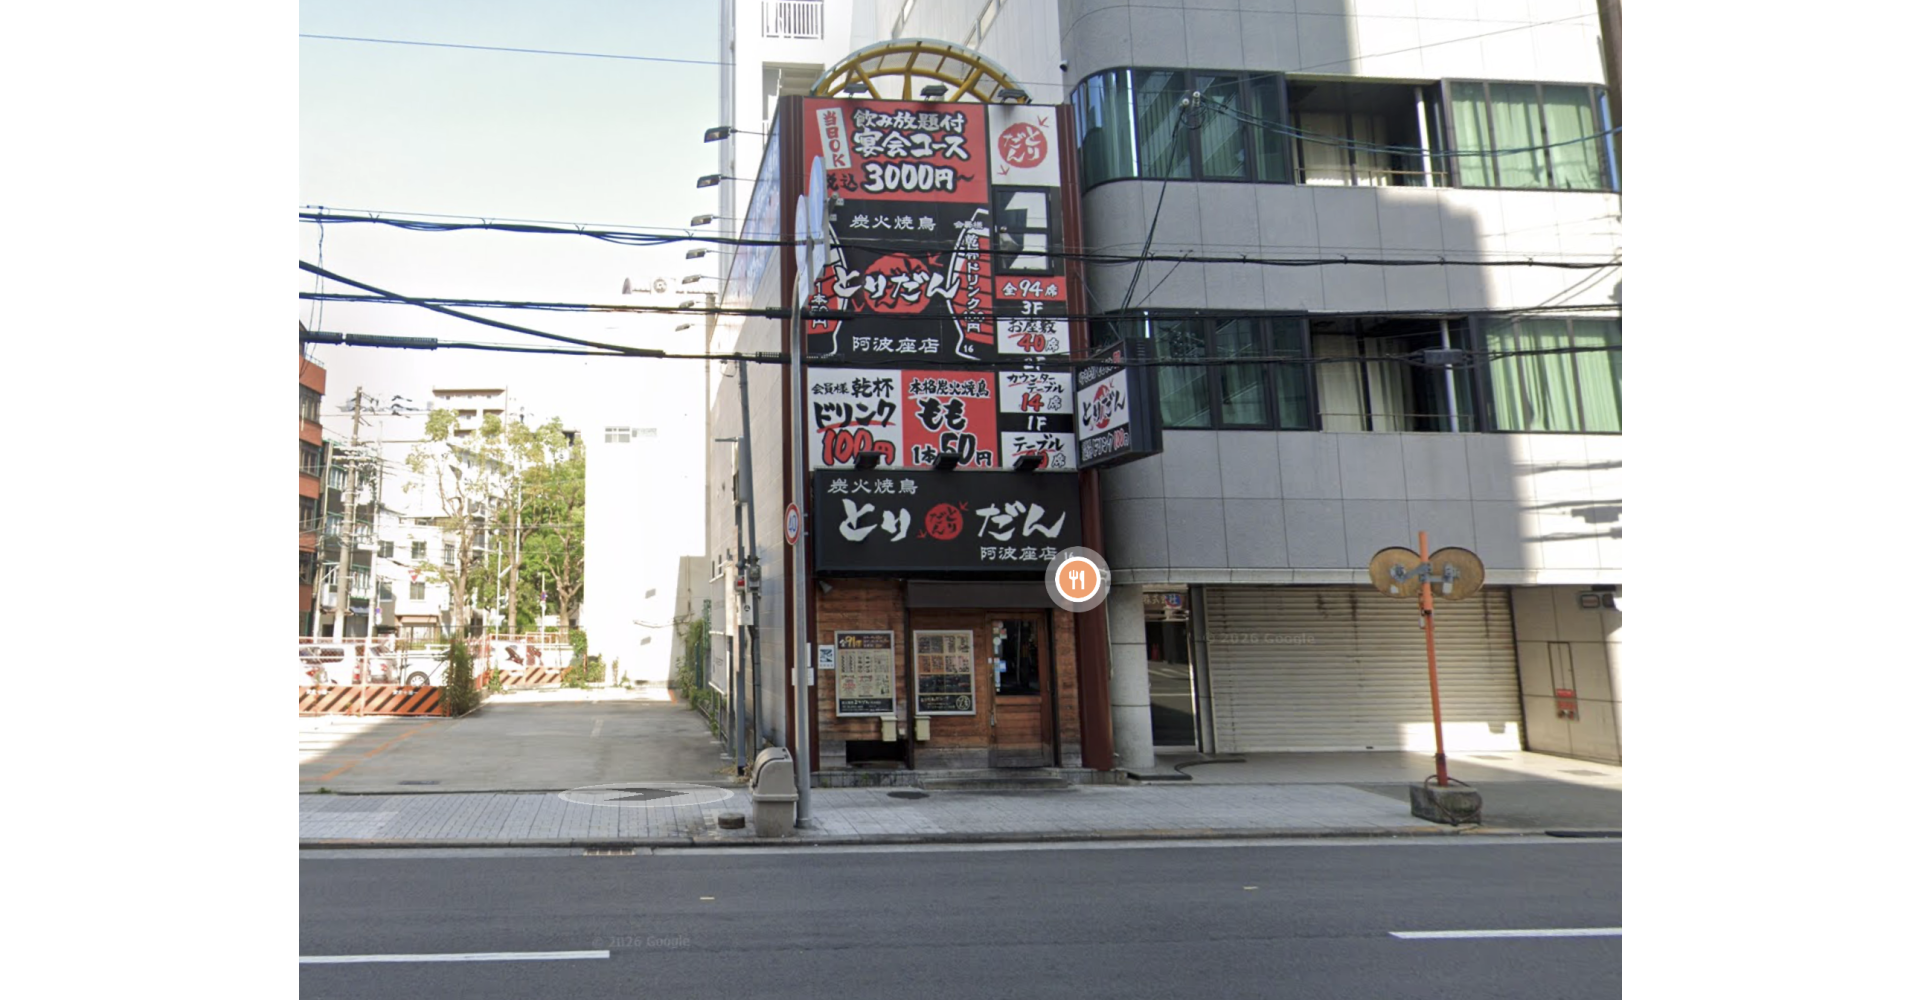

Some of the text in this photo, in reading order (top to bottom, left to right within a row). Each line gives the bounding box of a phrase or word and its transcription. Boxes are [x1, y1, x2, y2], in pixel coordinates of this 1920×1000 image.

[854, 109, 966, 133] 飲み放題付
[823, 111, 846, 168] 当日OK
[853, 129, 970, 160] 宴会コース
[850, 215, 936, 231] 炭火焼鳥
[833, 266, 960, 301] とりだん
[1003, 279, 1058, 297] 全94席
[1021, 300, 1043, 315] 3F
[852, 337, 939, 353] 阿波座店
[1017, 332, 1059, 352] 40席
[909, 378, 990, 397] 本格炭火焼鳥
[1007, 373, 1055, 384] カウンター
[1027, 382, 1064, 393] テーブル
[1021, 392, 1062, 412] 14席
[813, 399, 896, 429] ドリンク
[916, 398, 967, 431] もも
[1027, 415, 1047, 431] 1F
[822, 427, 896, 466] 100円
[911, 431, 993, 467] 1本50円
[1013, 434, 1065, 452] テーブル
[827, 479, 918, 494] 炭火焼鳥
[789, 514, 797, 532] 40
[839, 498, 1066, 541] とり だん
[980, 546, 1057, 561] 阿波座店
